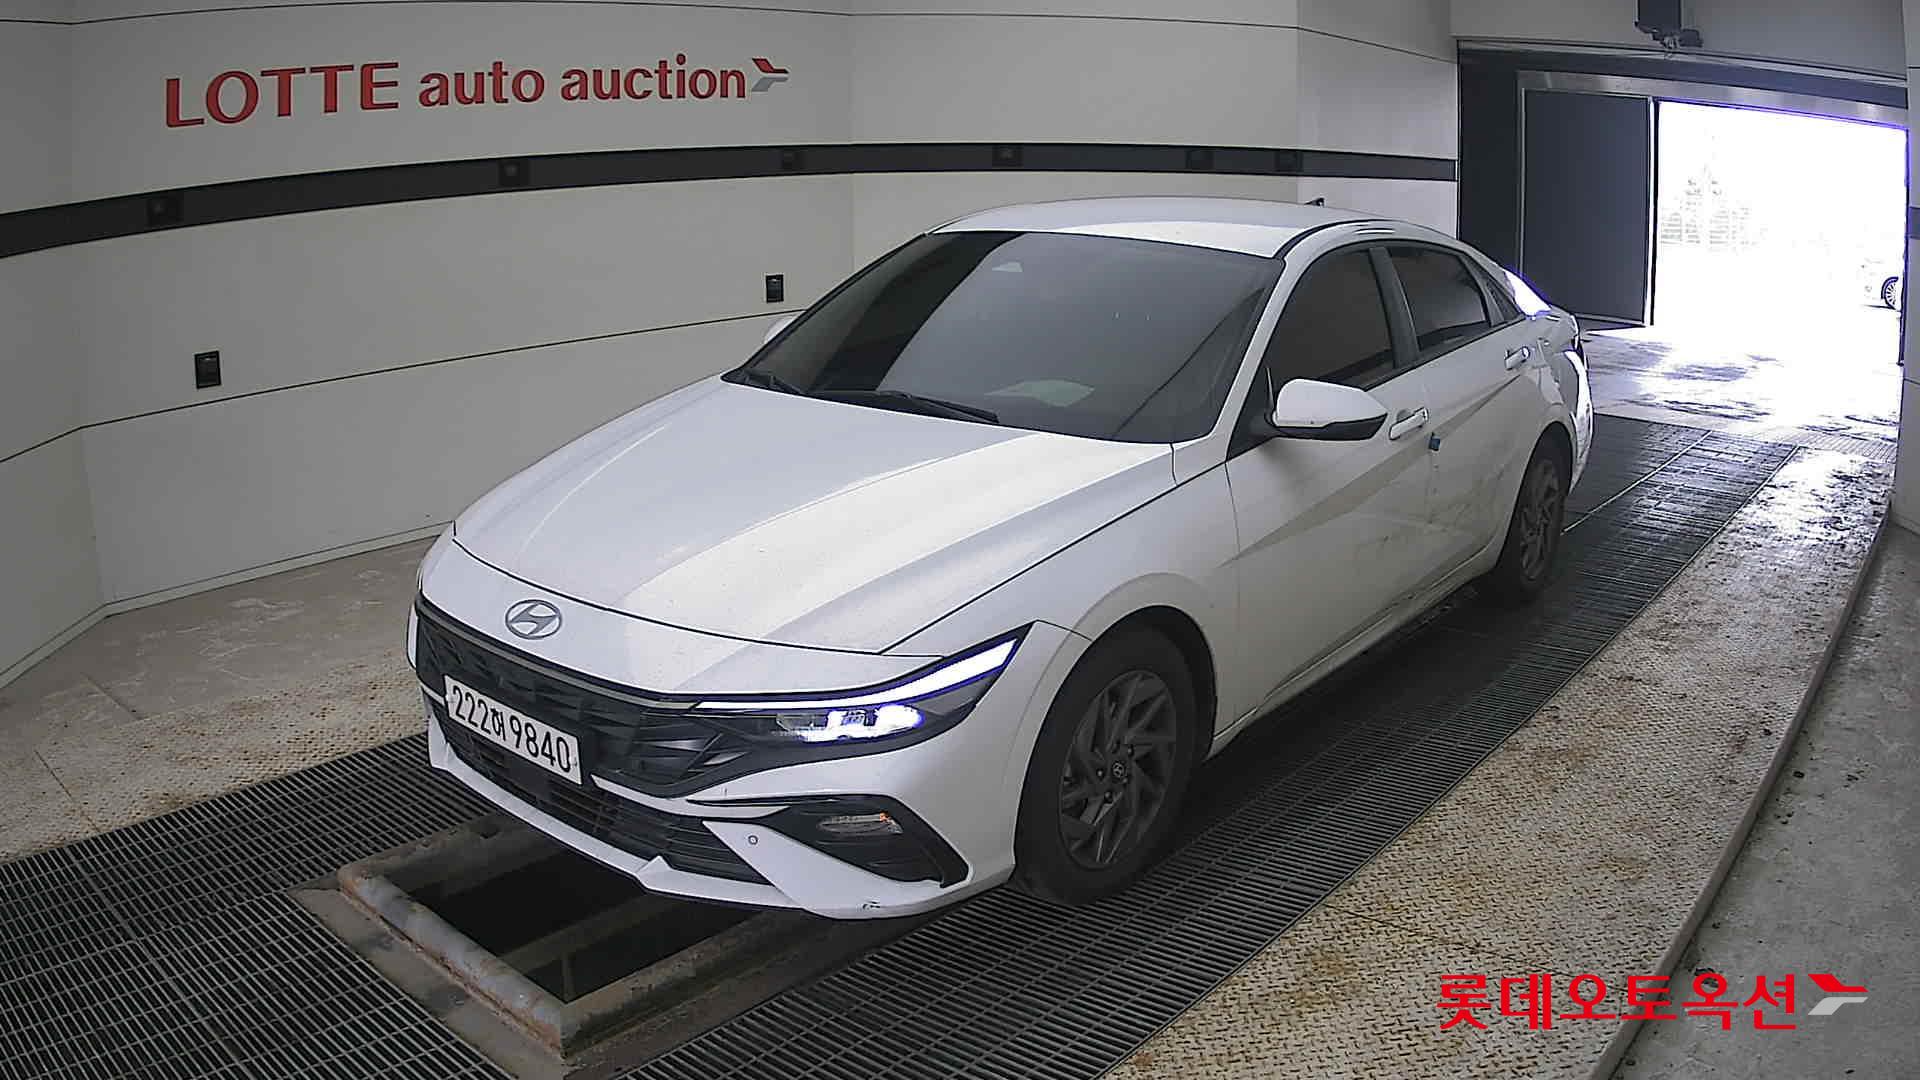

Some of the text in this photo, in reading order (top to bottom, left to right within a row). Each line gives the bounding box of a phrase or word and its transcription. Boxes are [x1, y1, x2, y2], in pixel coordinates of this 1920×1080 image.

[165, 55, 747, 128] LOTTE auto auction
[509, 715, 571, 773] 9840
